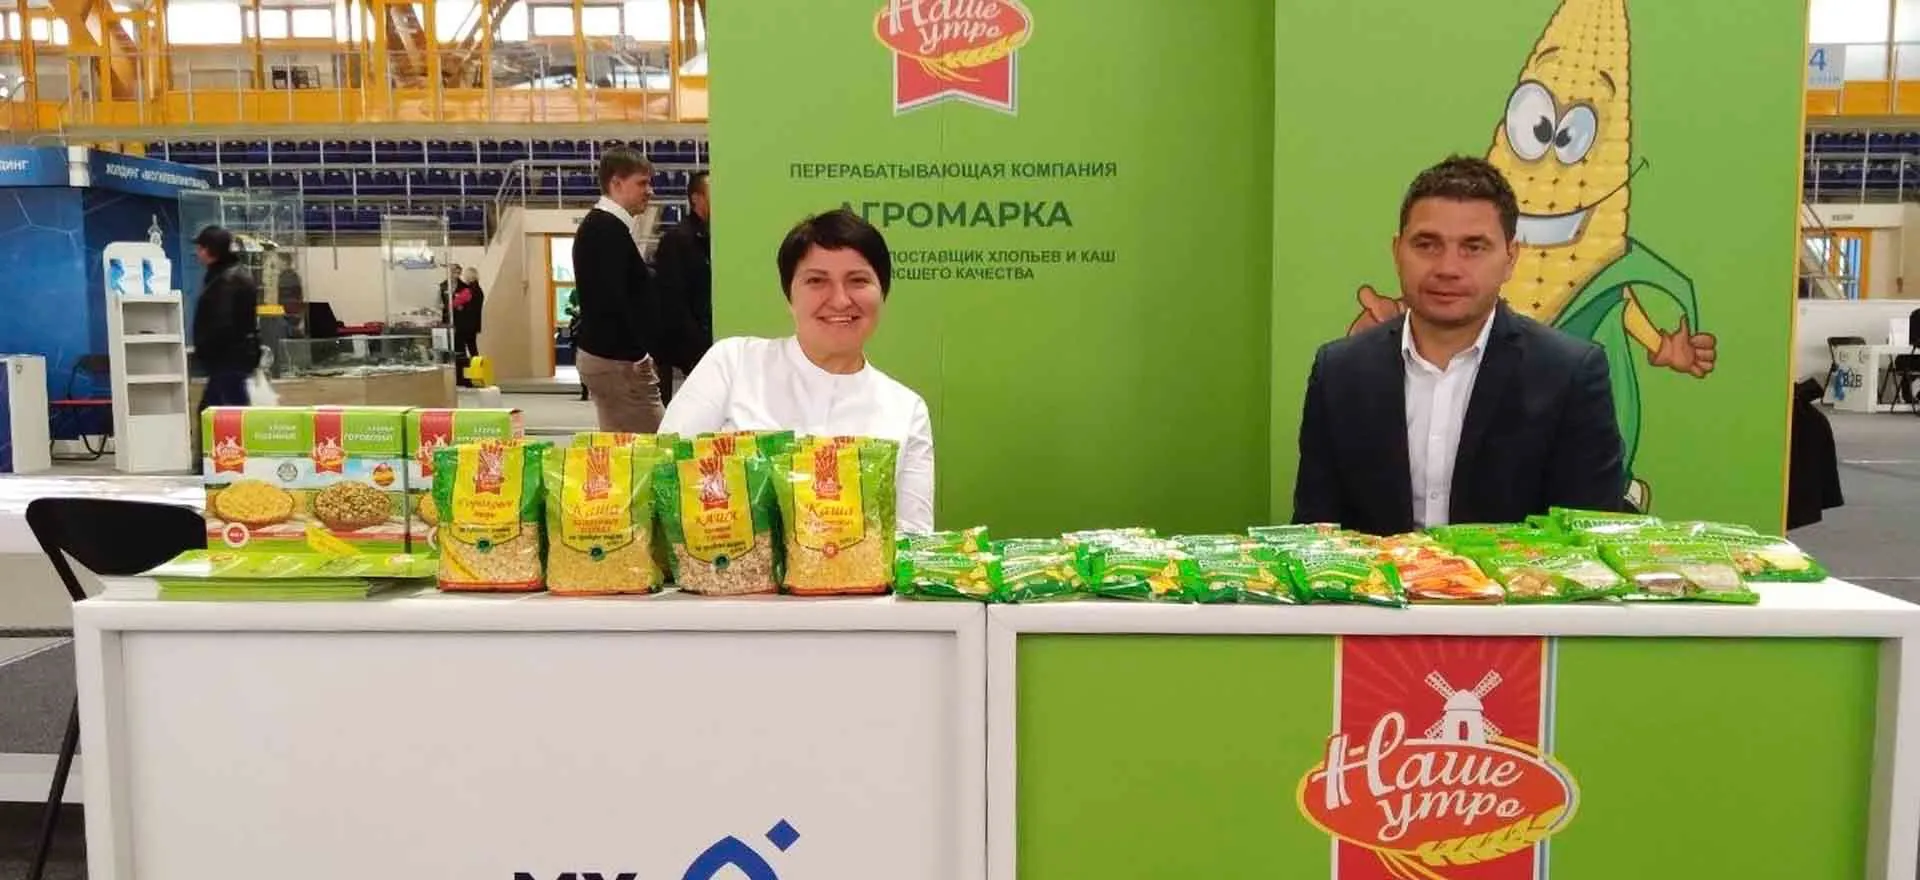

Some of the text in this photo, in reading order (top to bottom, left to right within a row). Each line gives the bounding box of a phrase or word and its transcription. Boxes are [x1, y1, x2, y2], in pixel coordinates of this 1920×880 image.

[919, 20, 1001, 54] утро
[1809, 48, 1826, 71] 4
[790, 162, 1118, 180] ПЕРЕРАБАТЫВАЮЩАЯ КОМПАНИЯ
[840, 201, 1073, 228] ГРОМАРКА
[989, 251, 1061, 264] ХЛОПЬЕВ
[1066, 251, 1077, 263] И
[1081, 250, 1116, 263] КАШ
[956, 267, 1035, 281] КАЧЕСТВА
[1311, 711, 1525, 810] Наше
[1376, 786, 1526, 842] утро
